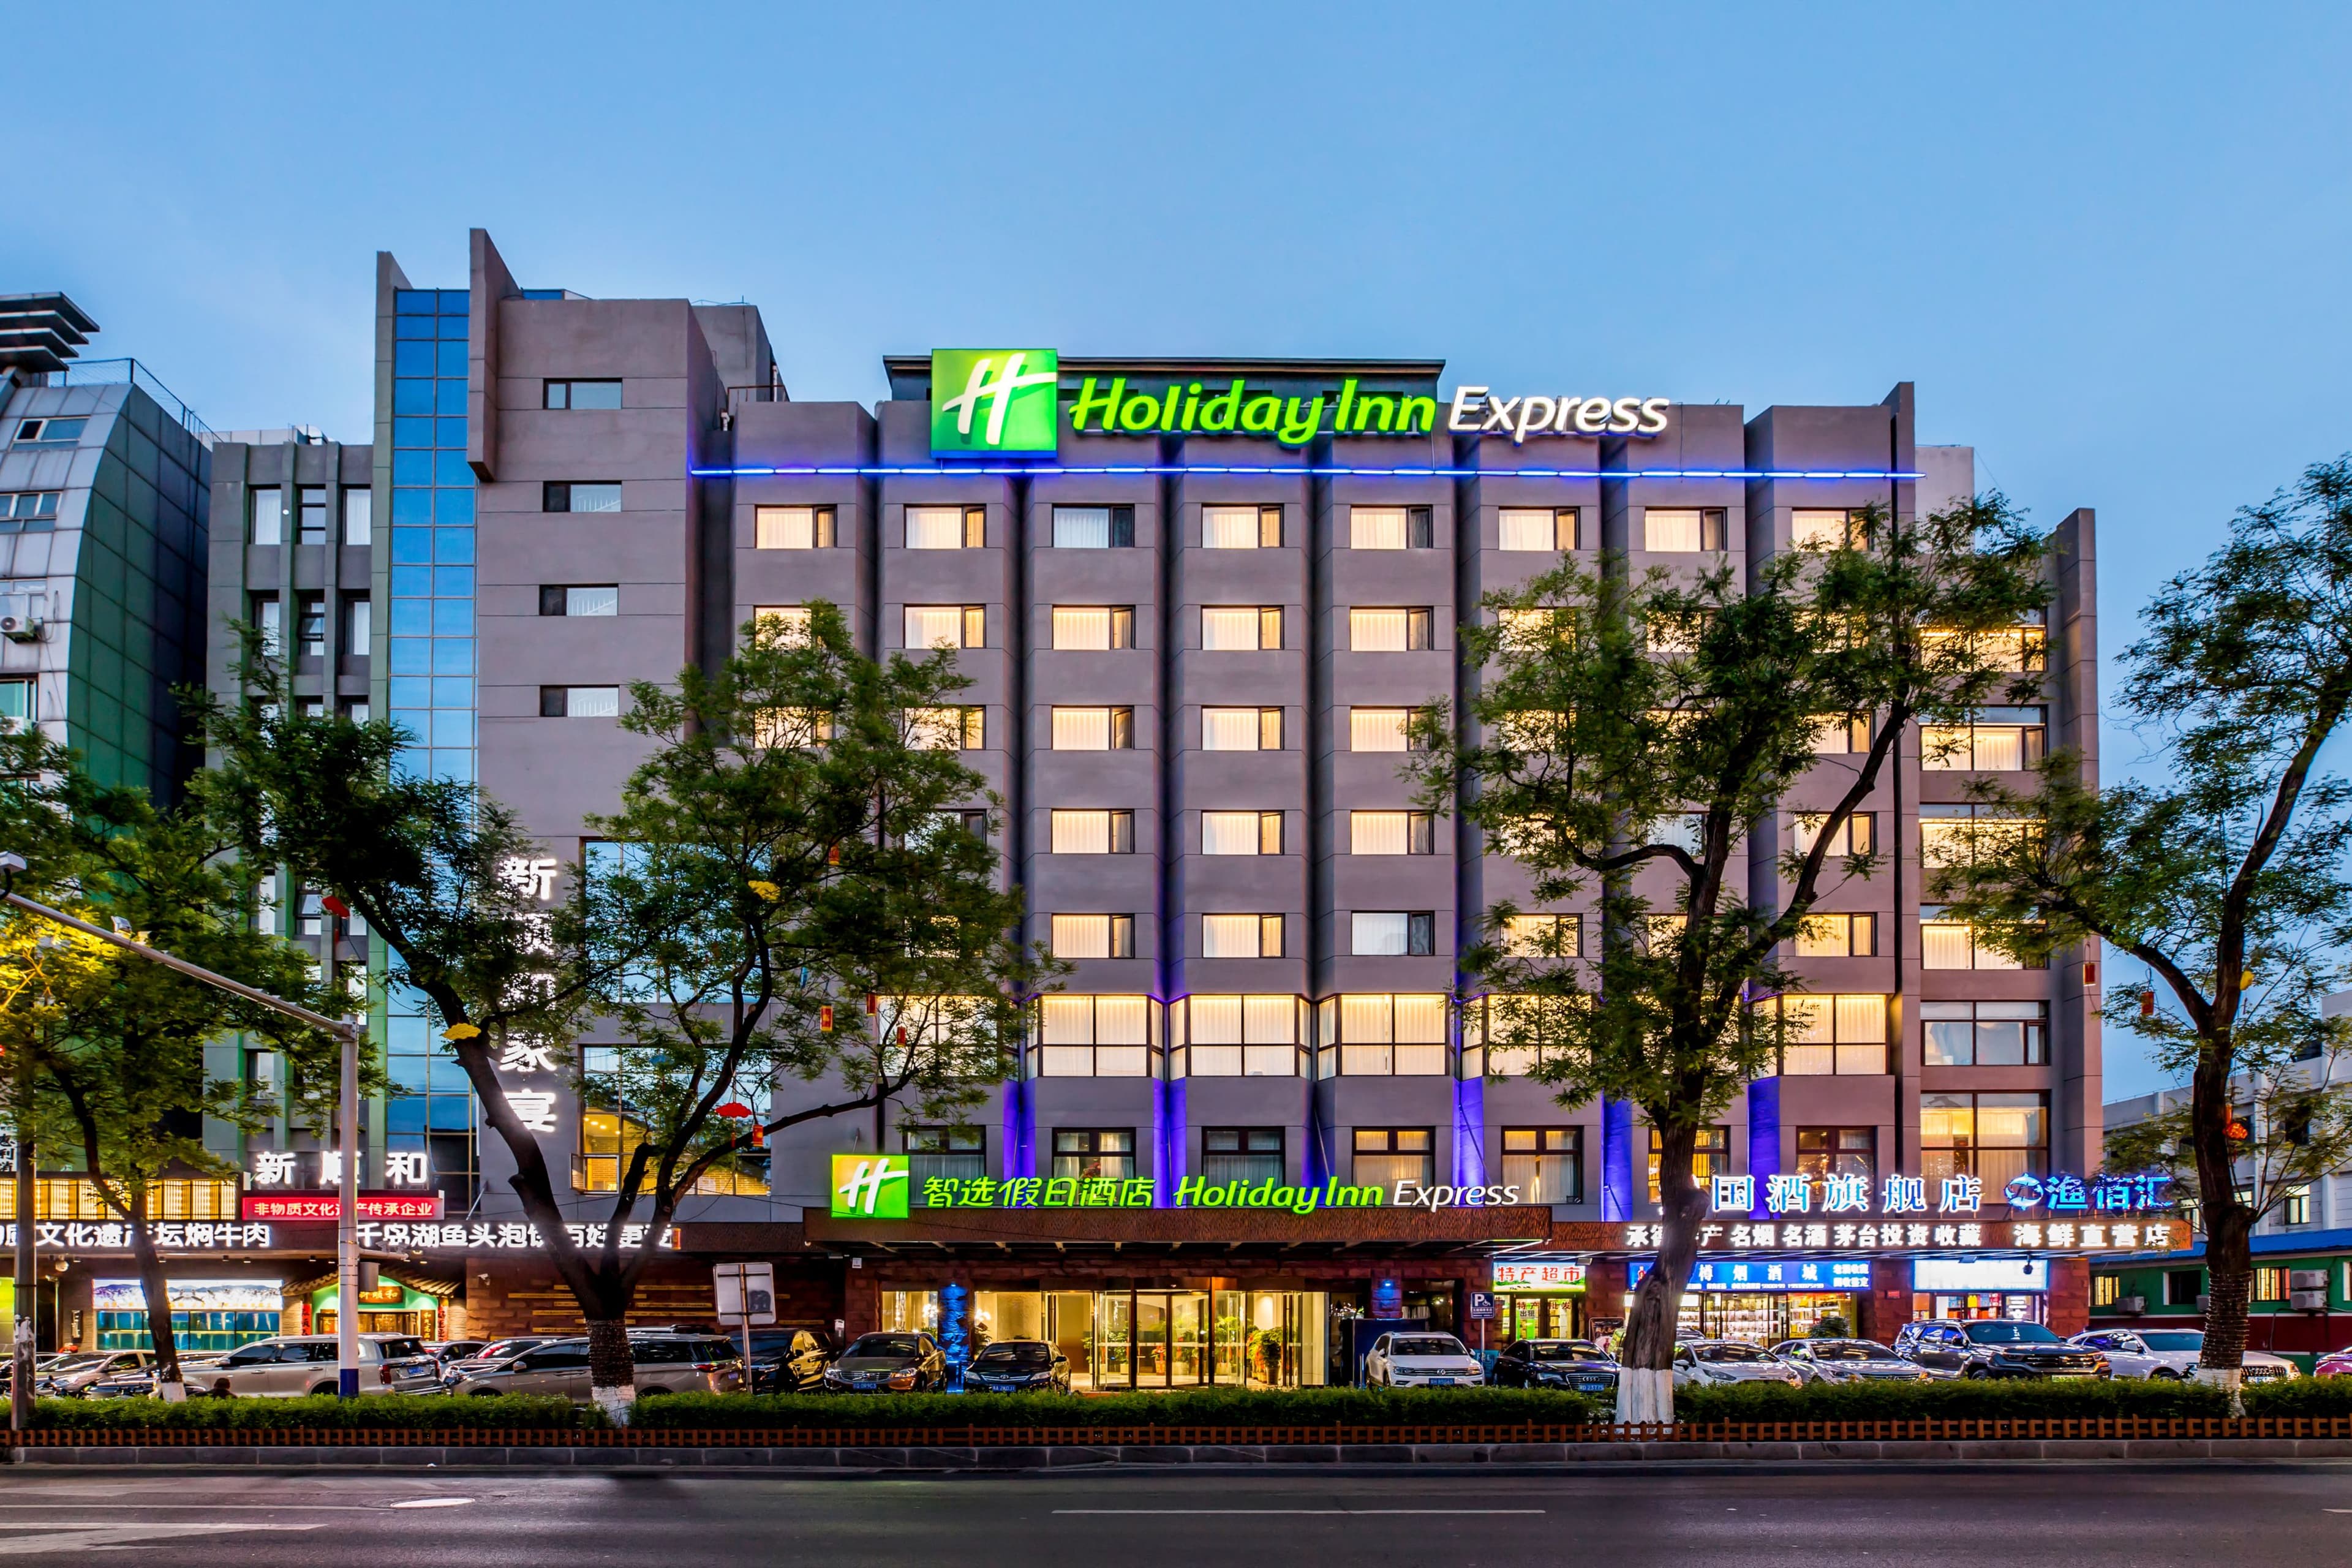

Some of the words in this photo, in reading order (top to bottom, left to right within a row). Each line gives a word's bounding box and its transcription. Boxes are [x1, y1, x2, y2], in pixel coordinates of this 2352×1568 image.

[1069, 377, 1325, 445] Holiday
[1335, 378, 1436, 434] Inn
[1448, 386, 1670, 445] Express
[922, 1175, 1156, 1208] 智选假日酒店
[1172, 1175, 1321, 1215] Holiday
[1325, 1176, 1384, 1207] Inn
[1393, 1180, 1521, 1213] Express
[1657, 1172, 1983, 1214] 国酒旗舰店
[254, 1202, 433, 1216] 非物质文化产传承企业
[0, 1222, 271, 1248] 文化遗坛焖牛肉
[2013, 1223, 2171, 1247] 海鲜直营店
[1498, 1267, 1580, 1281] 特产超市
[1474, 1294, 1485, 1306] P
